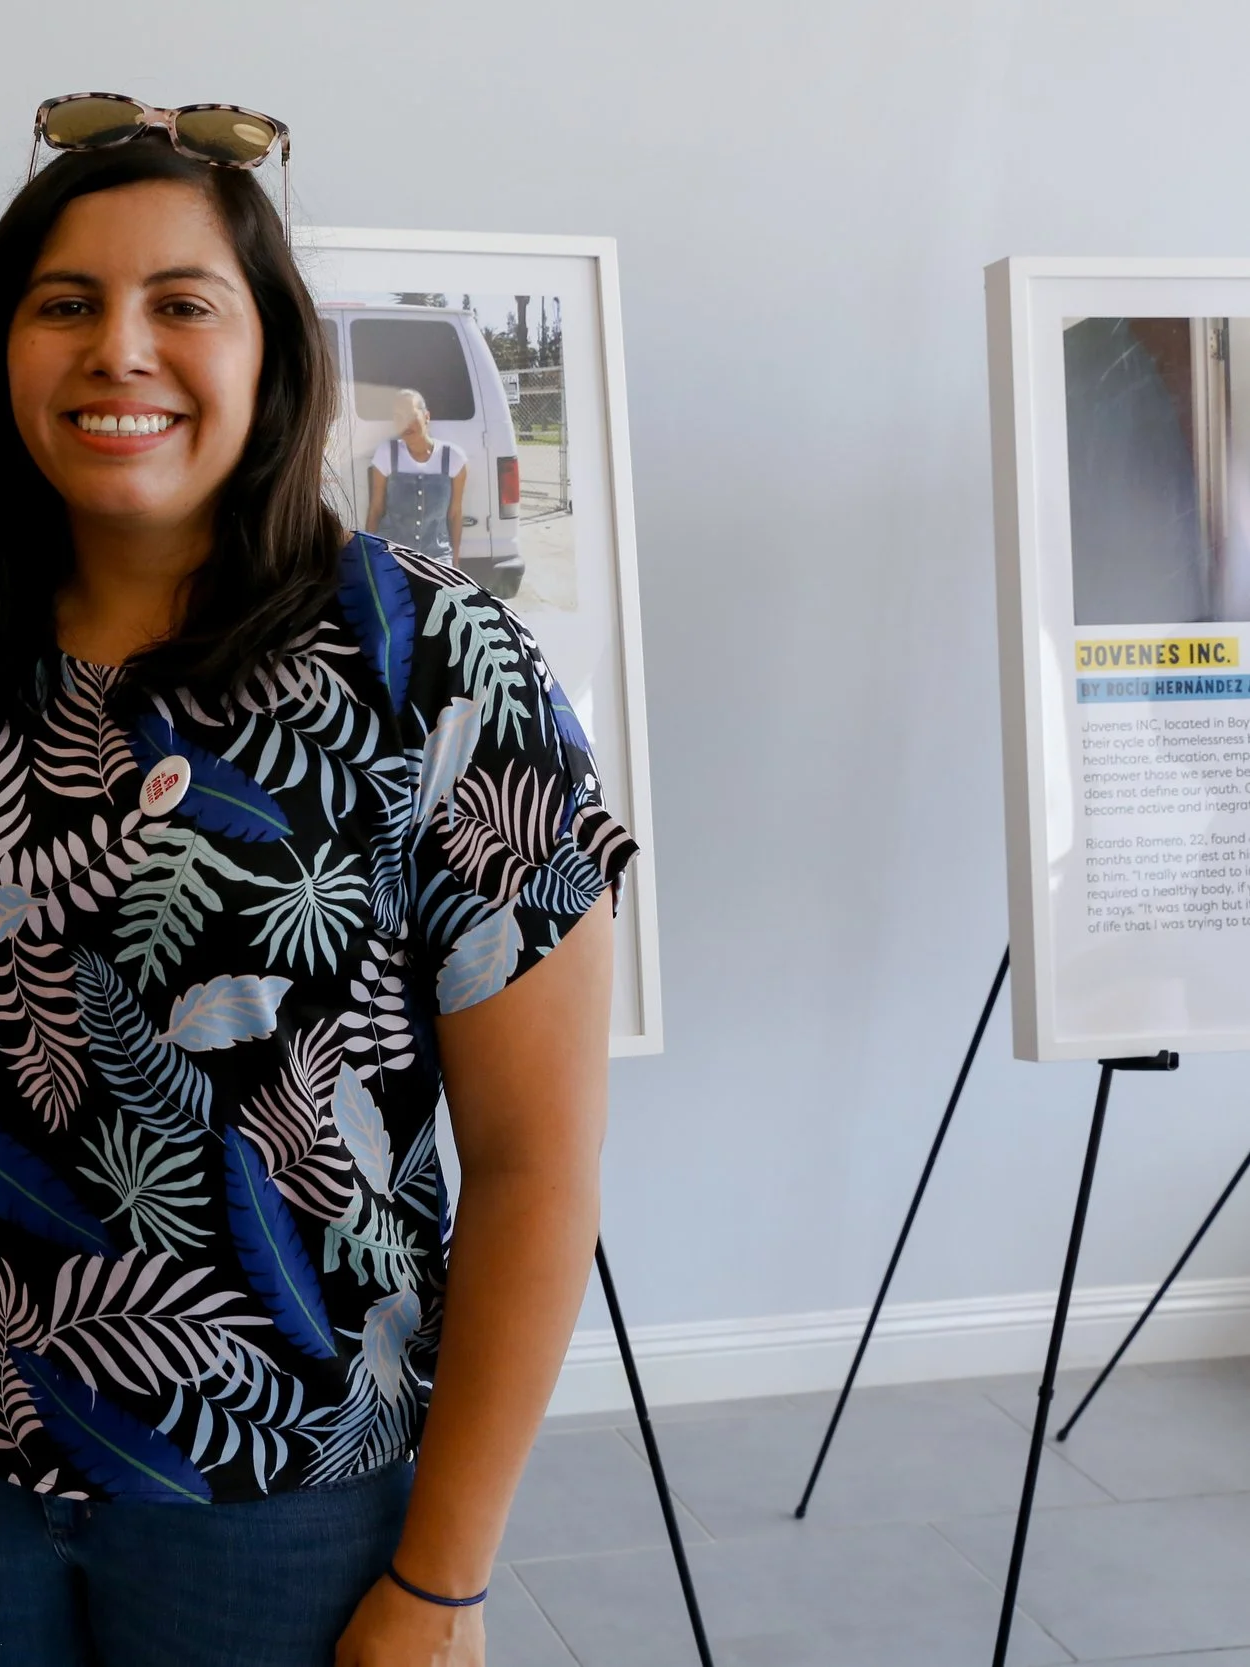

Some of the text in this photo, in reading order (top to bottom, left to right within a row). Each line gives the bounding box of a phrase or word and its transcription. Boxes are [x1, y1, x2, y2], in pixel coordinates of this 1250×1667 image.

[1080, 643, 1230, 666] JOVENES INC.
[1081, 675, 1243, 698] BY ROCÍO HERNÁNDEZ
[1081, 717, 1224, 733] Jovenes located in
[1162, 735, 1245, 747] homelessness
[1144, 769, 1233, 781] those serve
[1085, 832, 1246, 850] Ricardo found
[1186, 851, 1220, 864] priest
[1180, 866, 1226, 879] wanted
[1152, 884, 1199, 898] healthy
[1155, 899, 1243, 915] was tough but
[1124, 916, 1223, 932] that trying
